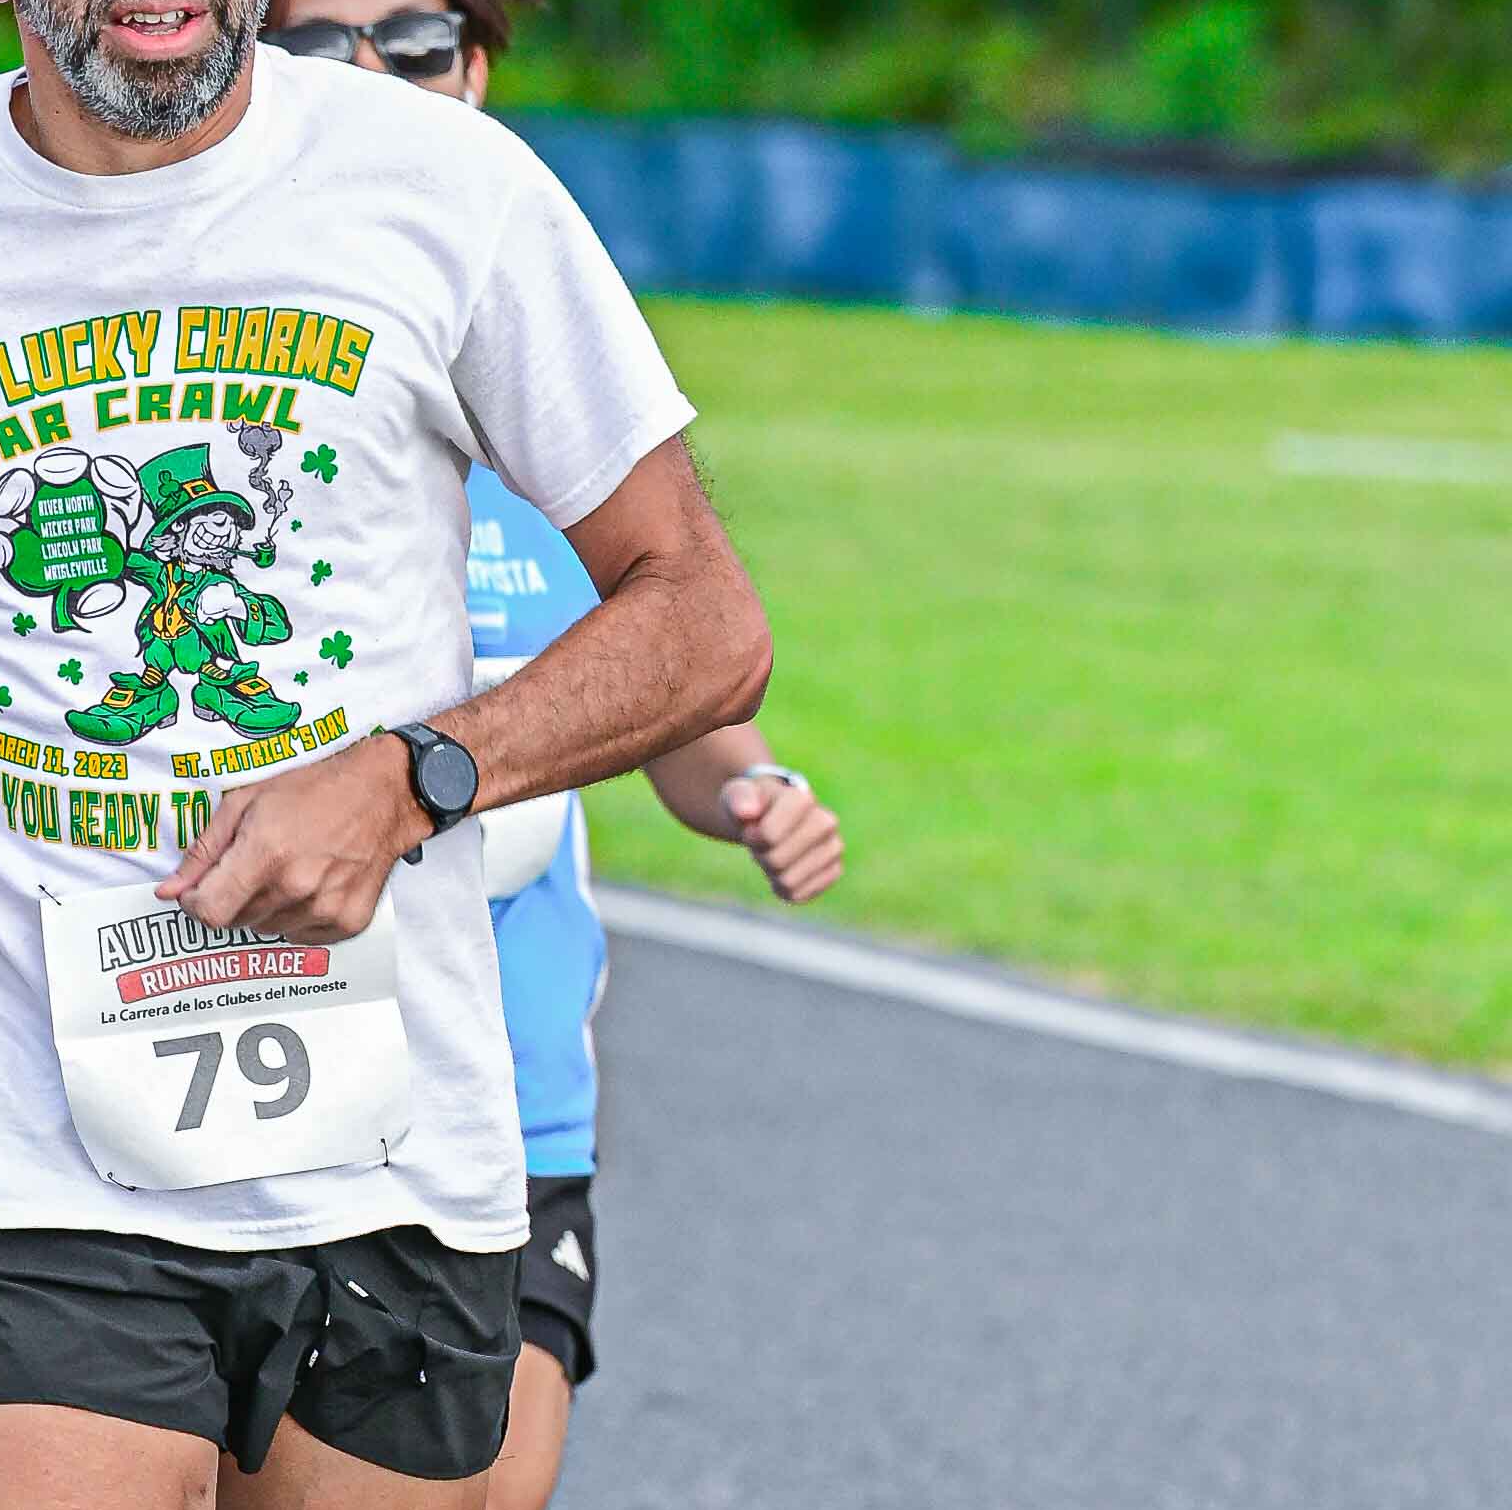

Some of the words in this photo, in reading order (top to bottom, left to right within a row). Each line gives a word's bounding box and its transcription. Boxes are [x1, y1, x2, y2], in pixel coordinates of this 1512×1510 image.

[175, 307, 374, 397] CHARMS
[94, 381, 303, 434] CRAWL
[38, 498, 64, 516] RIVER
[65, 495, 94, 513] NORTH
[40, 519, 73, 538] WICKER
[74, 517, 97, 535] PARK
[41, 540, 79, 560] LINCOLN
[80, 537, 104, 554] PARK
[44, 557, 108, 581] WRIGLEYVILLE
[42, 746, 69, 776] 11,
[73, 751, 128, 780] 2023
[171, 752, 209, 778] ST.
[210, 723, 317, 775] PATRICK'S
[313, 707, 349, 744] DAY
[1, 771, 62, 843] YOU
[69, 789, 160, 851] READY
[171, 789, 212, 849] TO
[140, 954, 240, 995] RUNNING
[248, 952, 305, 976] RACE
[101, 1011, 116, 1024] La
[120, 1005, 170, 1021] Carrera
[173, 1000, 190, 1013] de
[194, 997, 213, 1011] los
[216, 992, 261, 1007] Clubes
[265, 985, 285, 1000] del
[289, 979, 347, 998] Noroeste
[152, 1022, 312, 1132] 79
